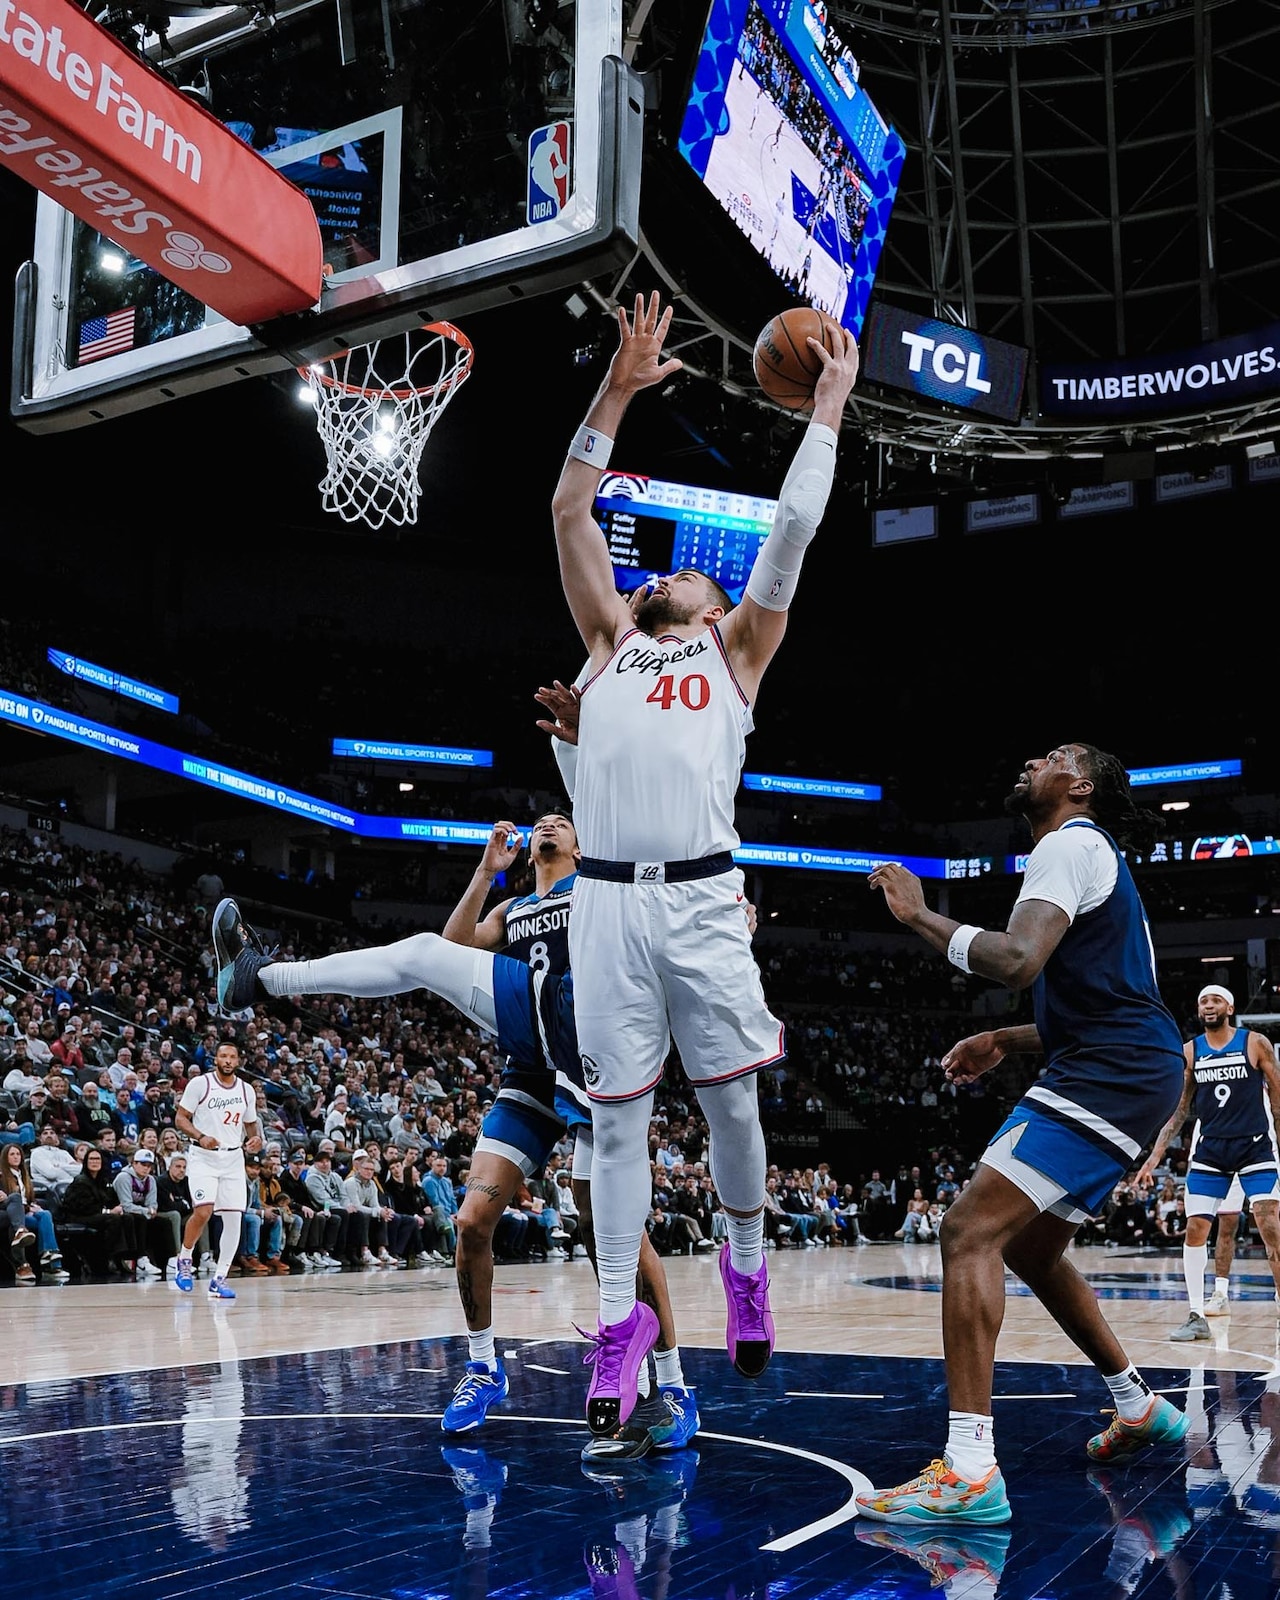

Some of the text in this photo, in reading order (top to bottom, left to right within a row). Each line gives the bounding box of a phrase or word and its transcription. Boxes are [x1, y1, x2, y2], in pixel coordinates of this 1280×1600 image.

[533, 200, 552, 220] NBA
[901, 330, 992, 394] TCL
[616, 641, 708, 676] Clippers
[646, 673, 711, 711] 40
[16, 701, 29, 718] ON
[44, 714, 79, 734] FANDUEL
[79, 725, 105, 742] SPORTS
[106, 735, 139, 754] NETWORK
[367, 745, 474, 762] FANDUEL SPORTS NETWORK
[1152, 769, 1182, 780] SPORTS
[1183, 765, 1221, 777] NETWORK
[182, 759, 354, 826] WATCH THE TIMBERWOLVES ON FANDUEL SPORTS NETWORK
[773, 780, 865, 796] FANDUEL SPORTS NETWORK
[37, 818, 52, 831] 113
[401, 824, 430, 836] WATCH
[432, 826, 448, 837] THE
[788, 852, 799, 862] ON
[812, 855, 844, 865] FANDUEL
[845, 857, 869, 867] SPORTS
[950, 860, 966, 869] POR
[984, 862, 991, 872] 3
[950, 869, 966, 878] DET
[529, 941, 550, 974] 8
[1194, 1065, 1248, 1083] MINNESOTA
[207, 1097, 242, 1110] Clippers
[1214, 1083, 1231, 1108] 9
[223, 1110, 240, 1126] 24
